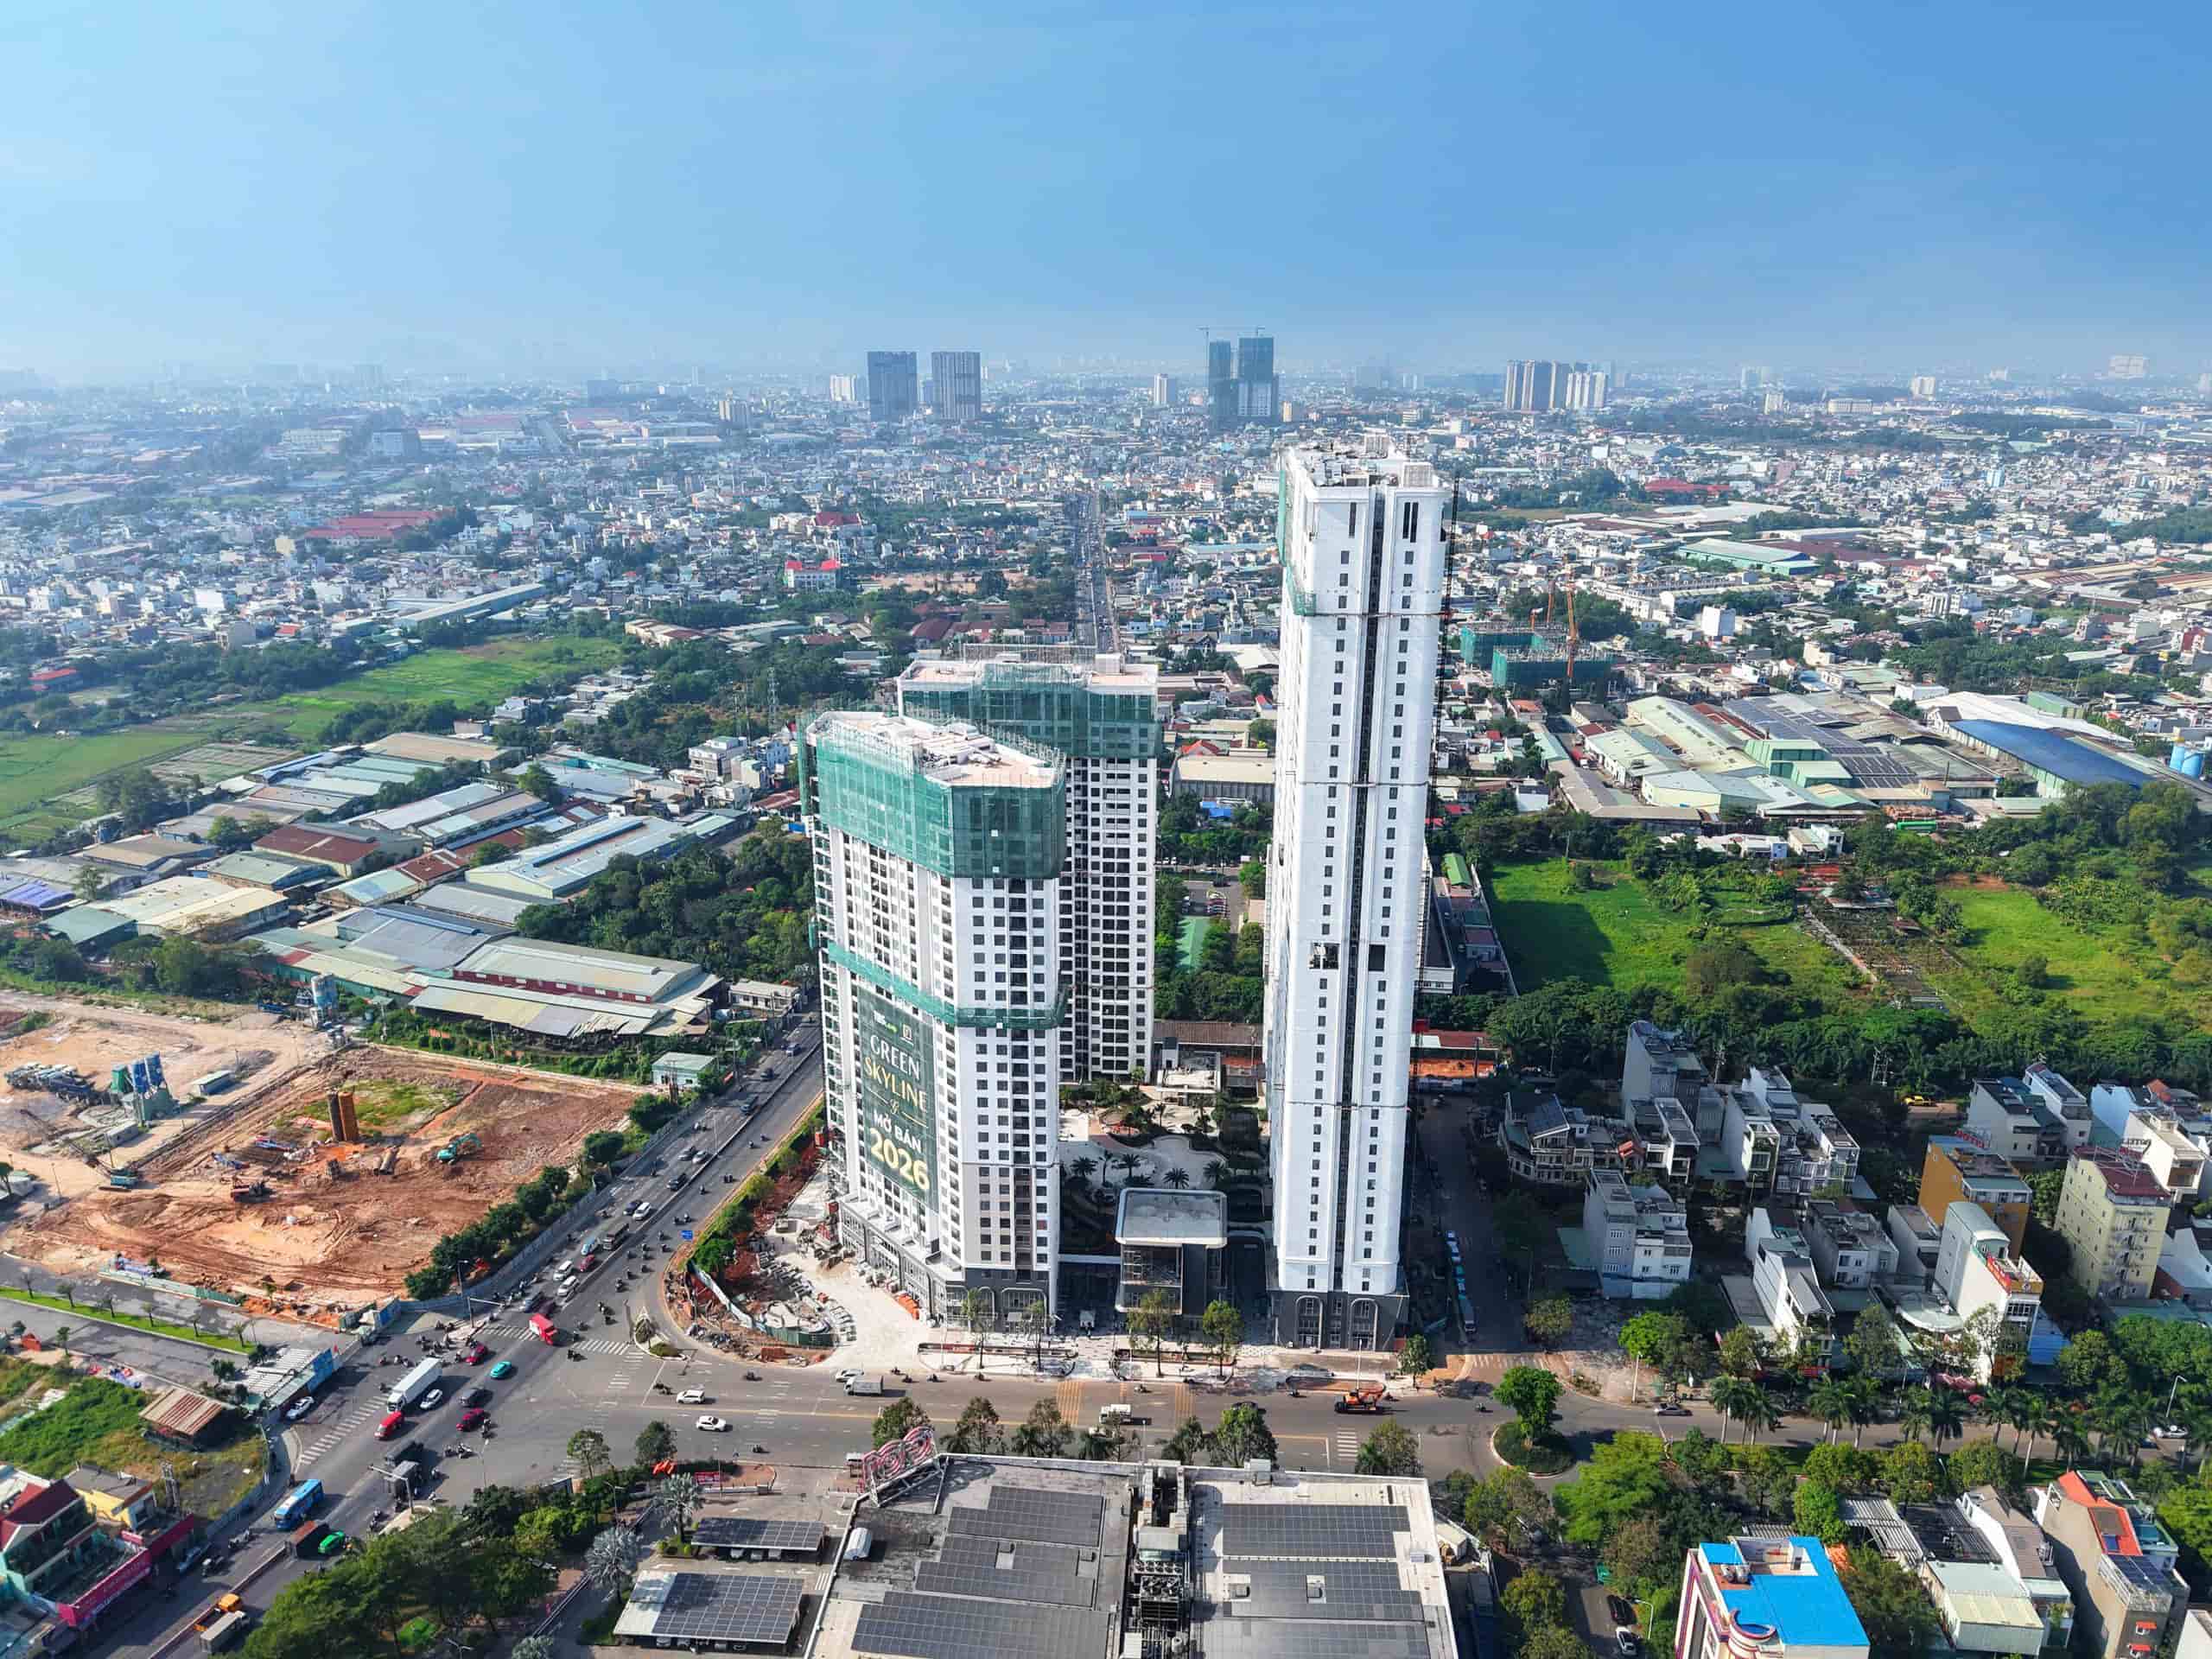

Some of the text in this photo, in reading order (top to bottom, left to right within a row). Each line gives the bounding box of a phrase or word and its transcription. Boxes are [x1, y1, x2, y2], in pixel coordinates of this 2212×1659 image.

[870, 1035, 919, 1079] GREEN
[865, 1057, 928, 1112] SKYLINE
[870, 1128, 930, 1190] 2026
[894, 1125, 922, 1154] BÁN
